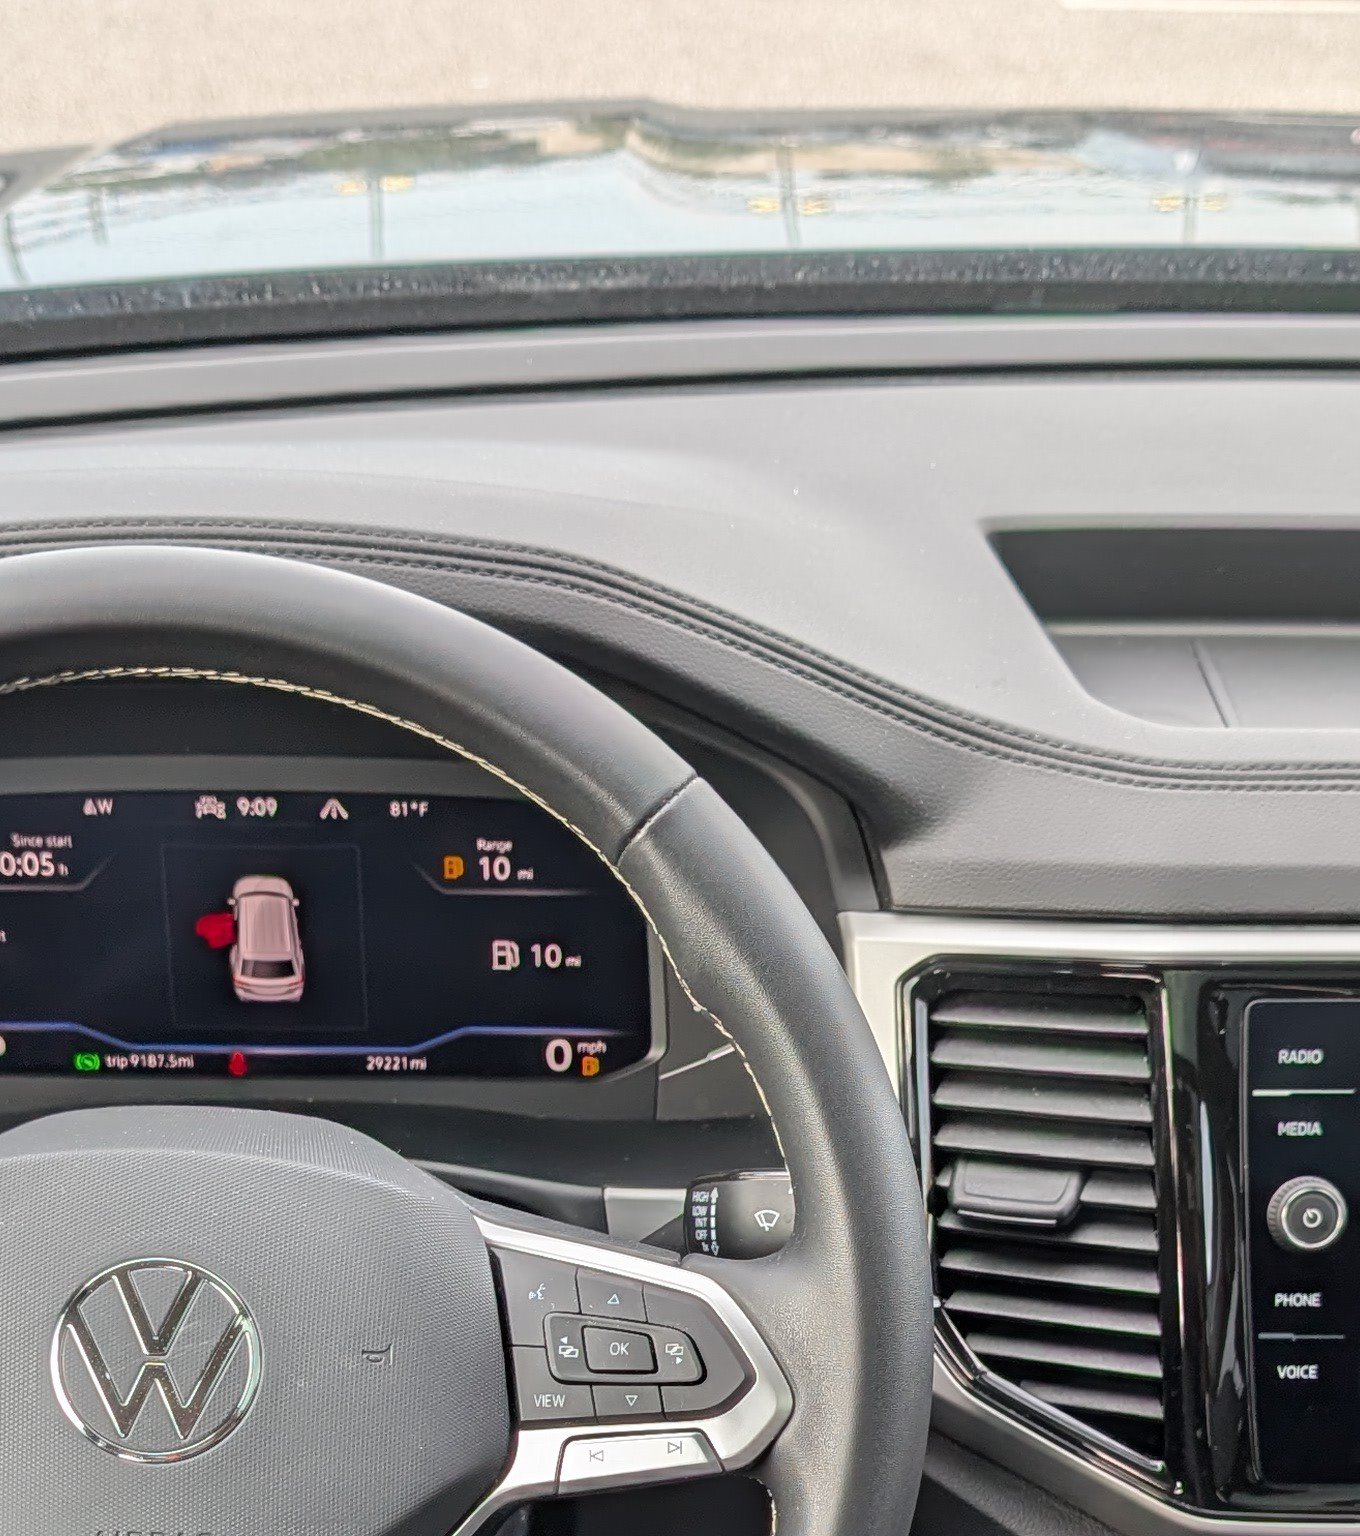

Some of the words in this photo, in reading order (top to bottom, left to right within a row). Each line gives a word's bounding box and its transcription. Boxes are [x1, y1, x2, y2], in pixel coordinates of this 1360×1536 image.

[237, 798, 277, 816] 9:09
[10, 832, 44, 848] Since
[45, 834, 73, 849] start
[476, 838, 513, 853] Range
[478, 856, 511, 882] 10
[517, 868, 534, 881] mi
[531, 943, 562, 969] 10
[565, 955, 582, 968] mi
[104, 1053, 129, 1070] trip
[544, 1038, 573, 1073] 0
[576, 1040, 608, 1055] mph
[1277, 1048, 1325, 1065] RADIO
[1276, 1120, 1323, 1137] MEDIA
[1274, 1291, 1322, 1308] PHONE
[608, 1342, 630, 1357] OK
[1276, 1363, 1320, 1380] VOICE
[533, 1394, 566, 1409] VIEW
